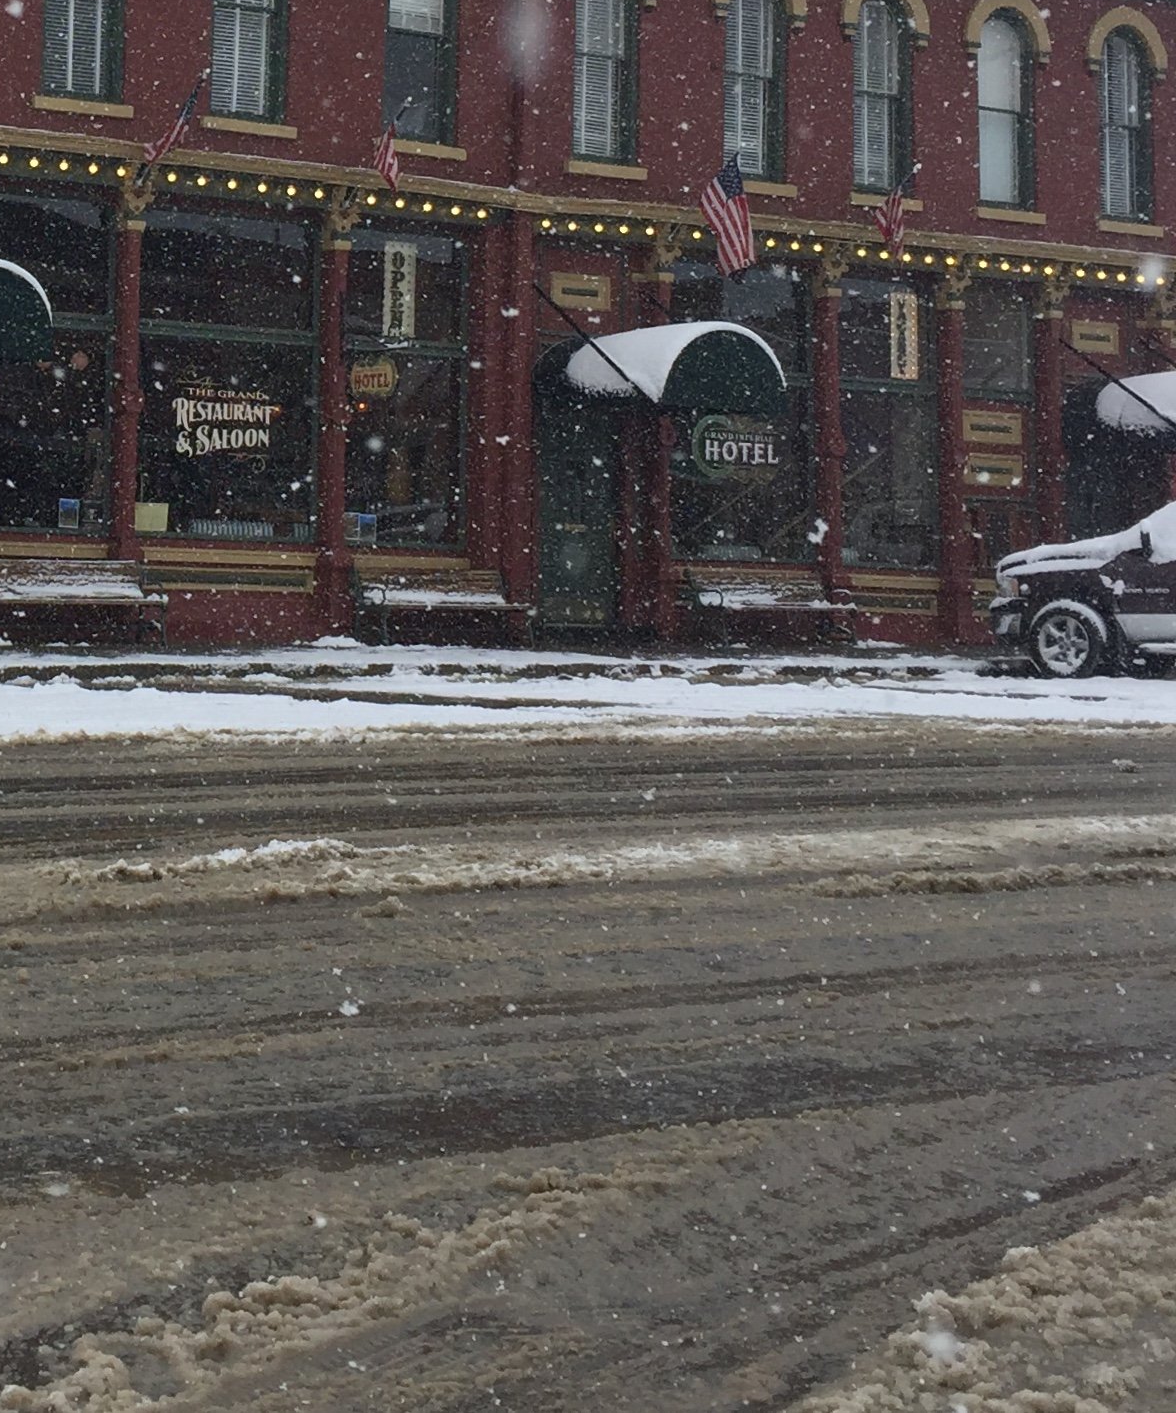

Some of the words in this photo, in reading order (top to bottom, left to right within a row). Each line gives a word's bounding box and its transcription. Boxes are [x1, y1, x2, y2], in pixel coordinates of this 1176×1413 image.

[354, 372, 391, 389] HOTEL
[188, 387, 215, 398] THE
[218, 389, 267, 400] GRAND
[172, 397, 277, 432] RESTAURANT
[176, 431, 193, 458] &
[195, 425, 270, 455] SALOON
[705, 431, 734, 441] GRAND
[705, 439, 779, 464] HOTEL
